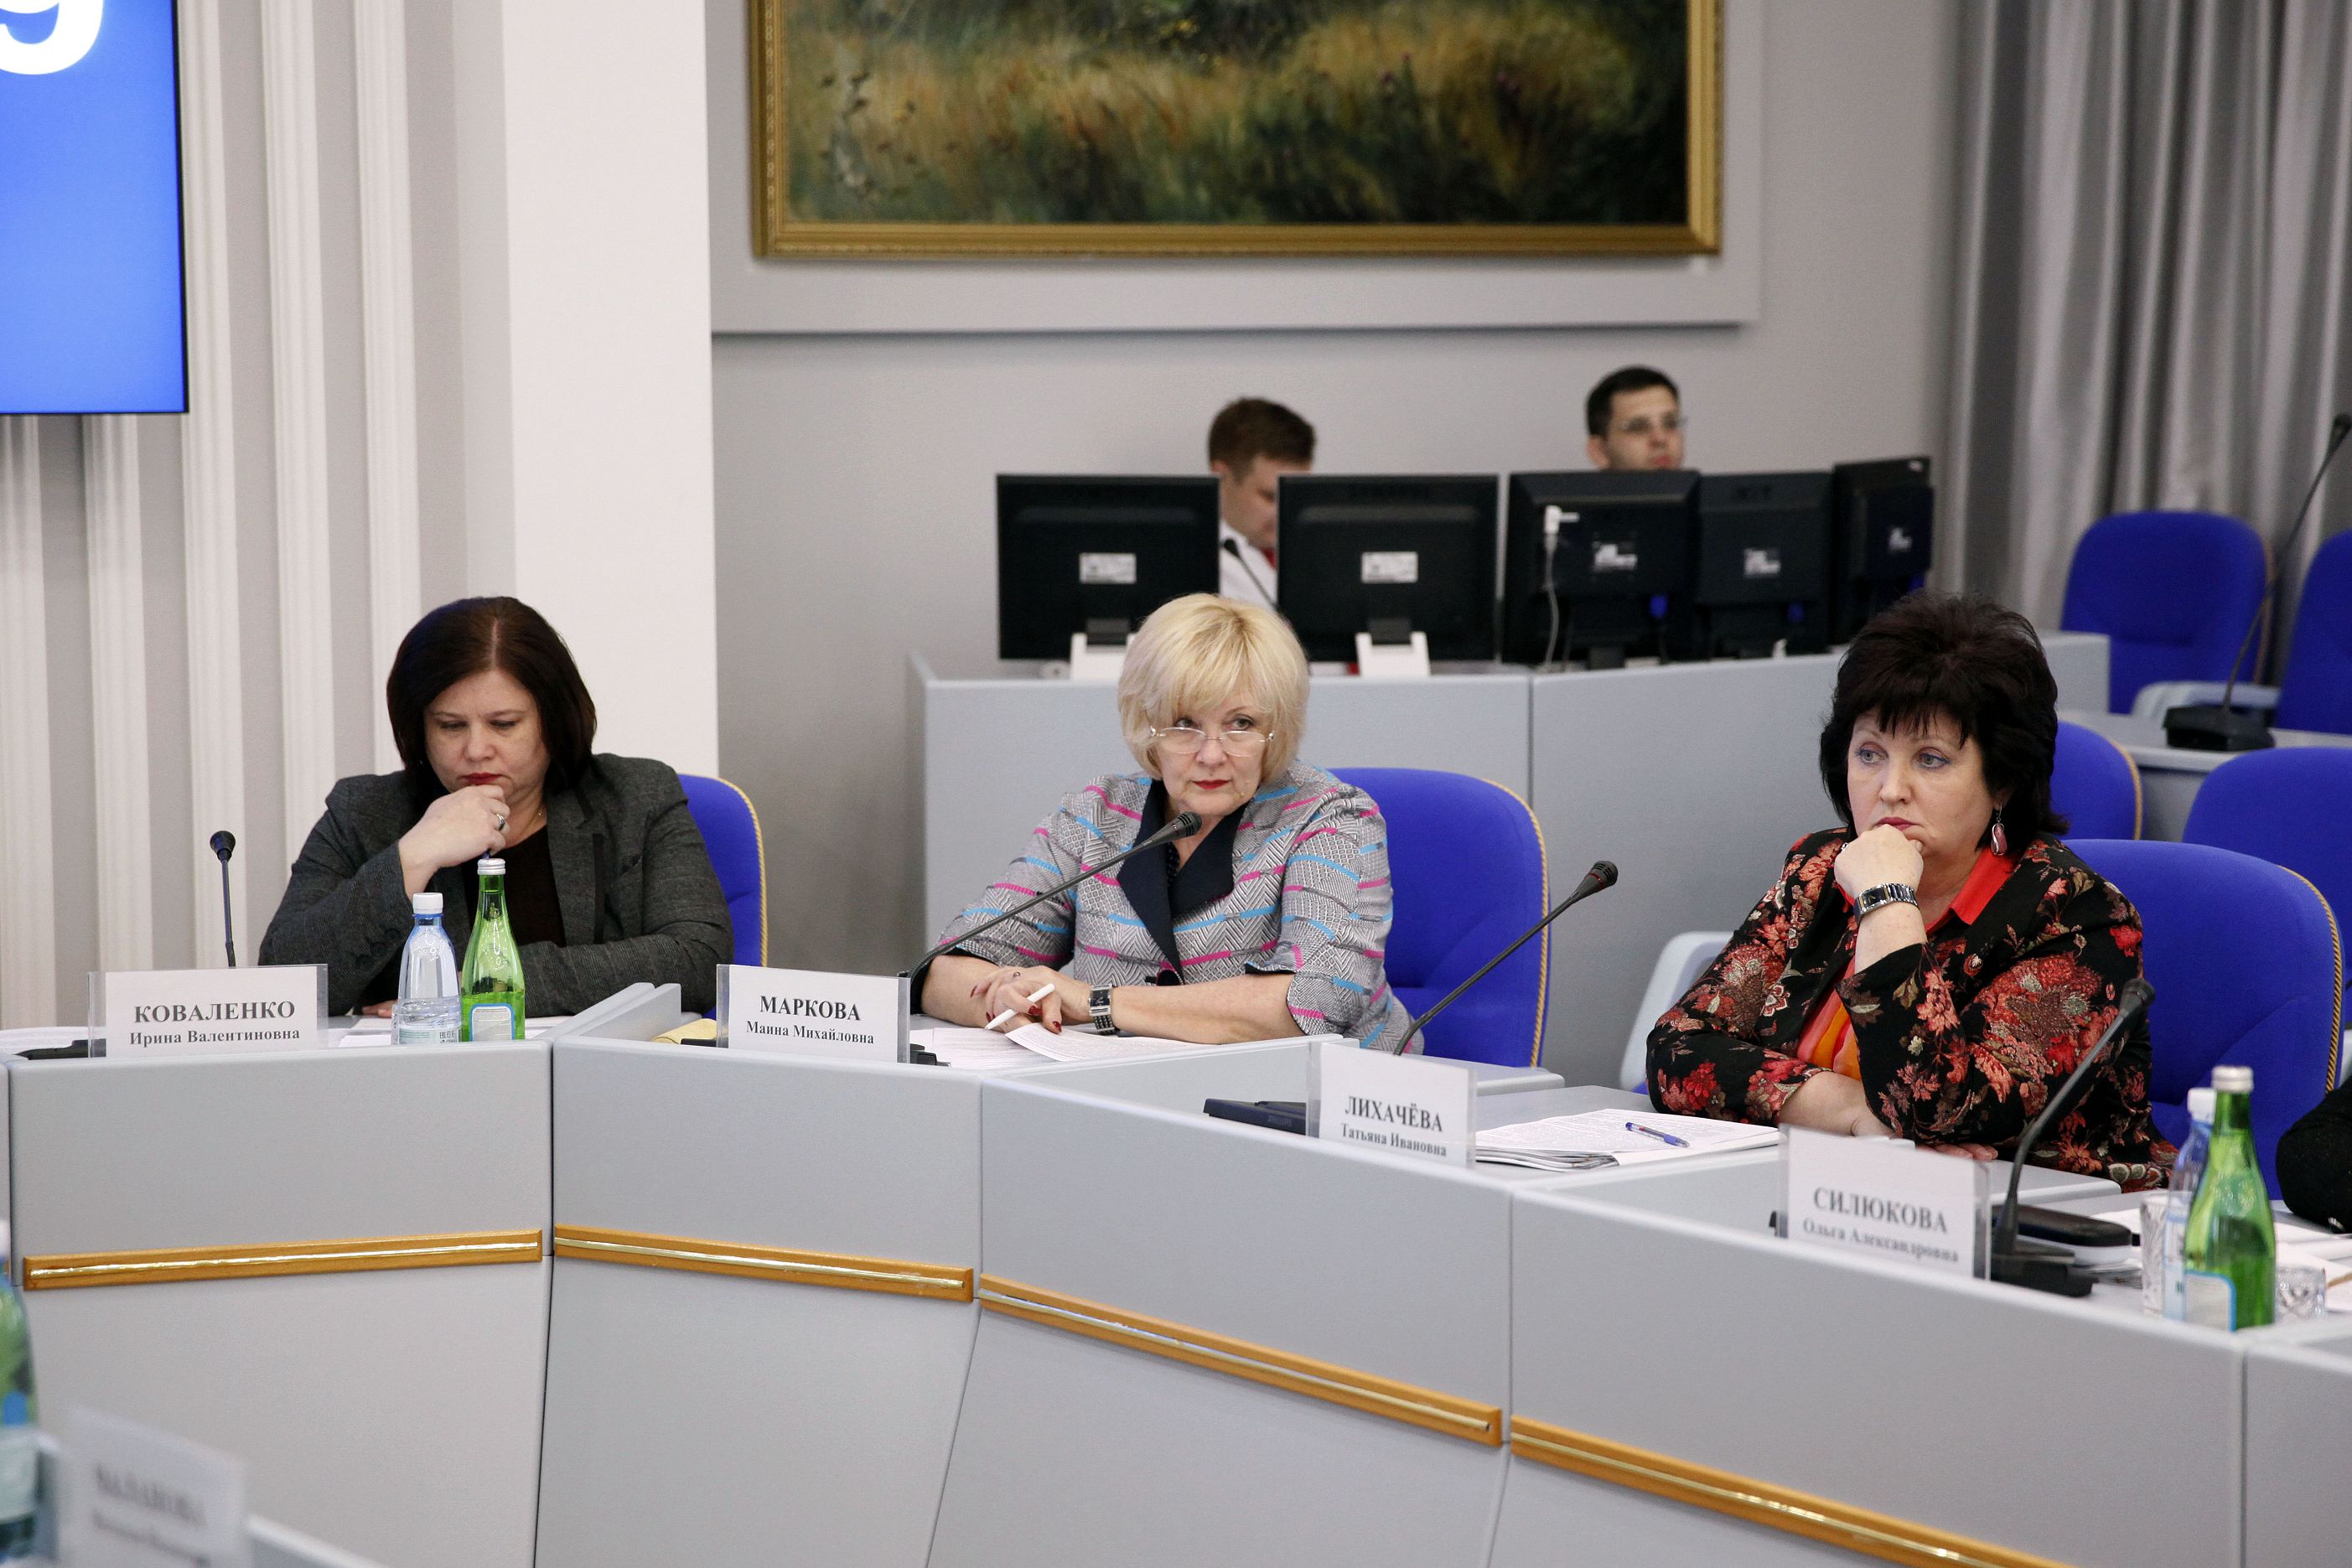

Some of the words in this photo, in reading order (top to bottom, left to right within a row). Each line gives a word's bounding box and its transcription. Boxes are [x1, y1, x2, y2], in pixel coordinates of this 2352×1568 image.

[134, 1001, 295, 1022] КОВАЛЕНКО
[759, 995, 862, 1022] МАРКОВА
[130, 1032, 182, 1047] Ирина
[187, 1028, 300, 1043] Валентиновна
[746, 1020, 789, 1037] Маина
[792, 1025, 874, 1044] Михайловна
[1344, 1096, 1443, 1132] ЛИХАЧЁВА
[1340, 1123, 1387, 1145] Татьяна
[1390, 1133, 1447, 1157] Ивановна
[1814, 1187, 1947, 1234] СИЛЮКОВА
[1803, 1217, 1847, 1240] Ольга
[1851, 1227, 1959, 1262] Александровна
